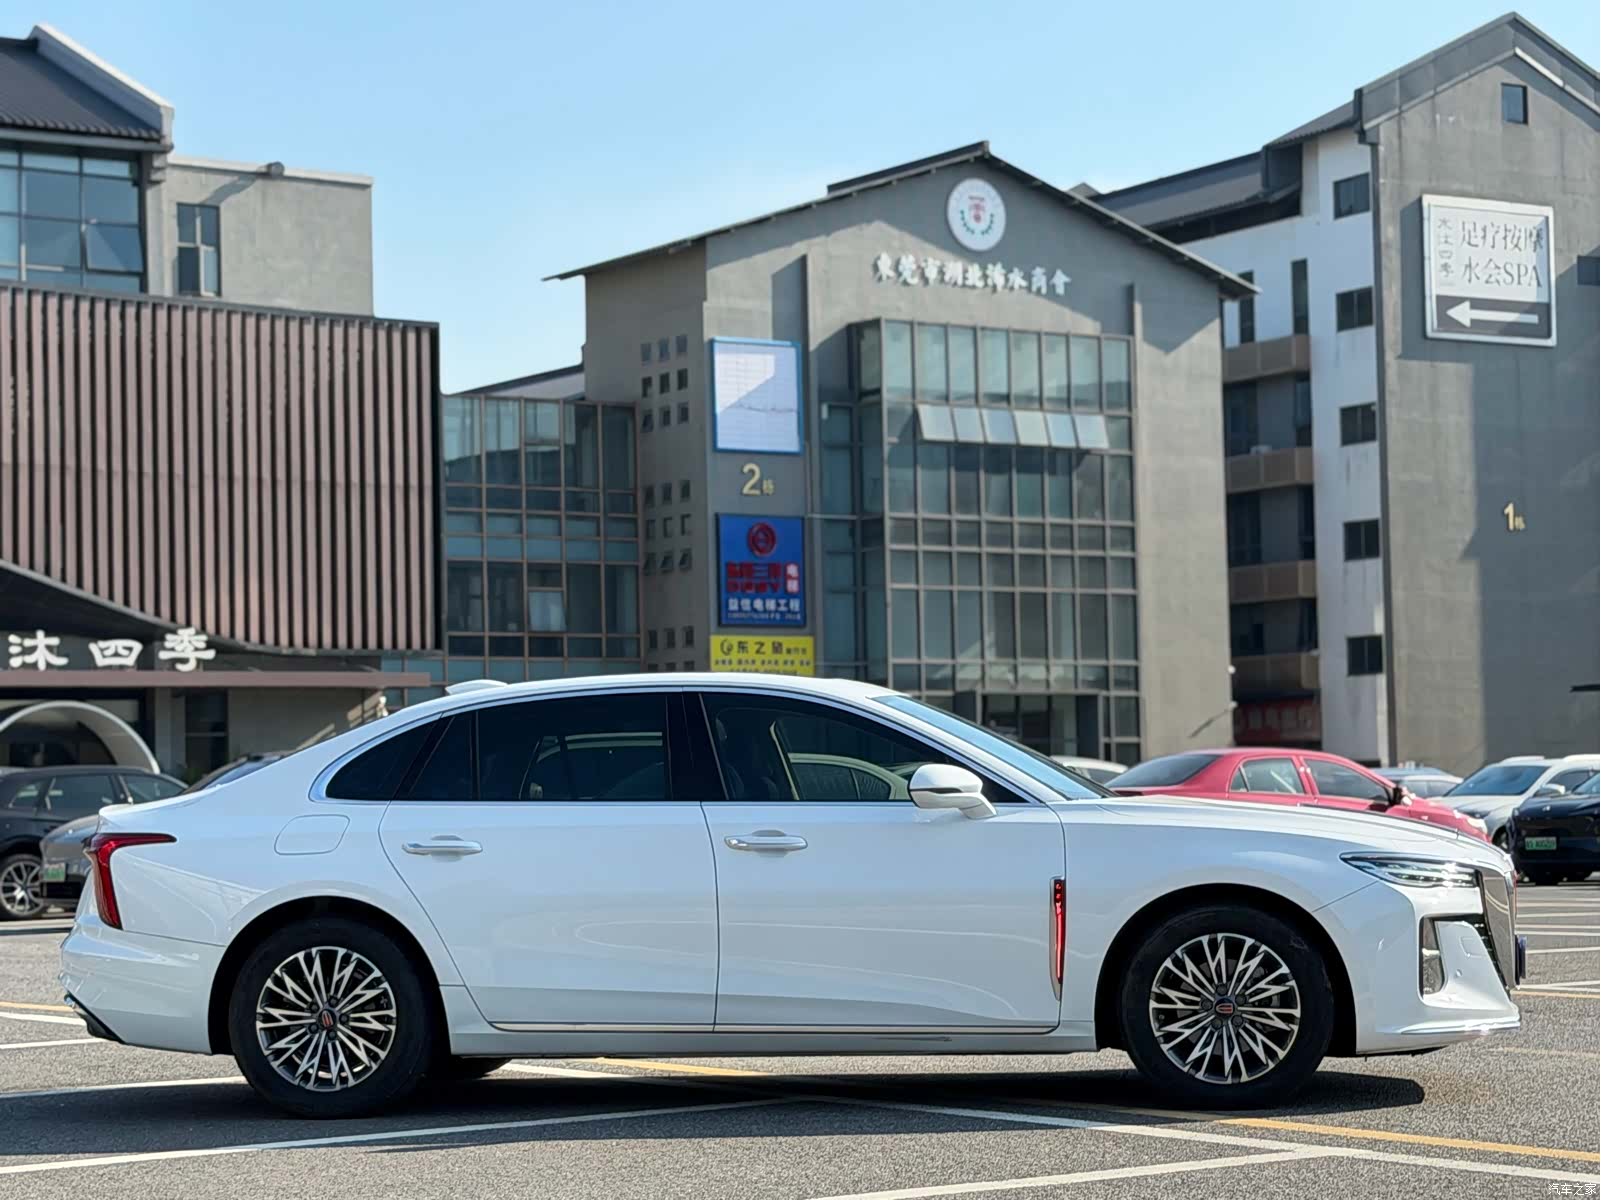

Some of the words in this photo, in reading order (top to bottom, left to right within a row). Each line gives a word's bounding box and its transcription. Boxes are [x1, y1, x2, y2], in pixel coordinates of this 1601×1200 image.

[1460, 220, 1544, 253] 足疗按摩
[1462, 255, 1543, 288] 水会SPA
[8, 627, 217, 672] 沐四季
